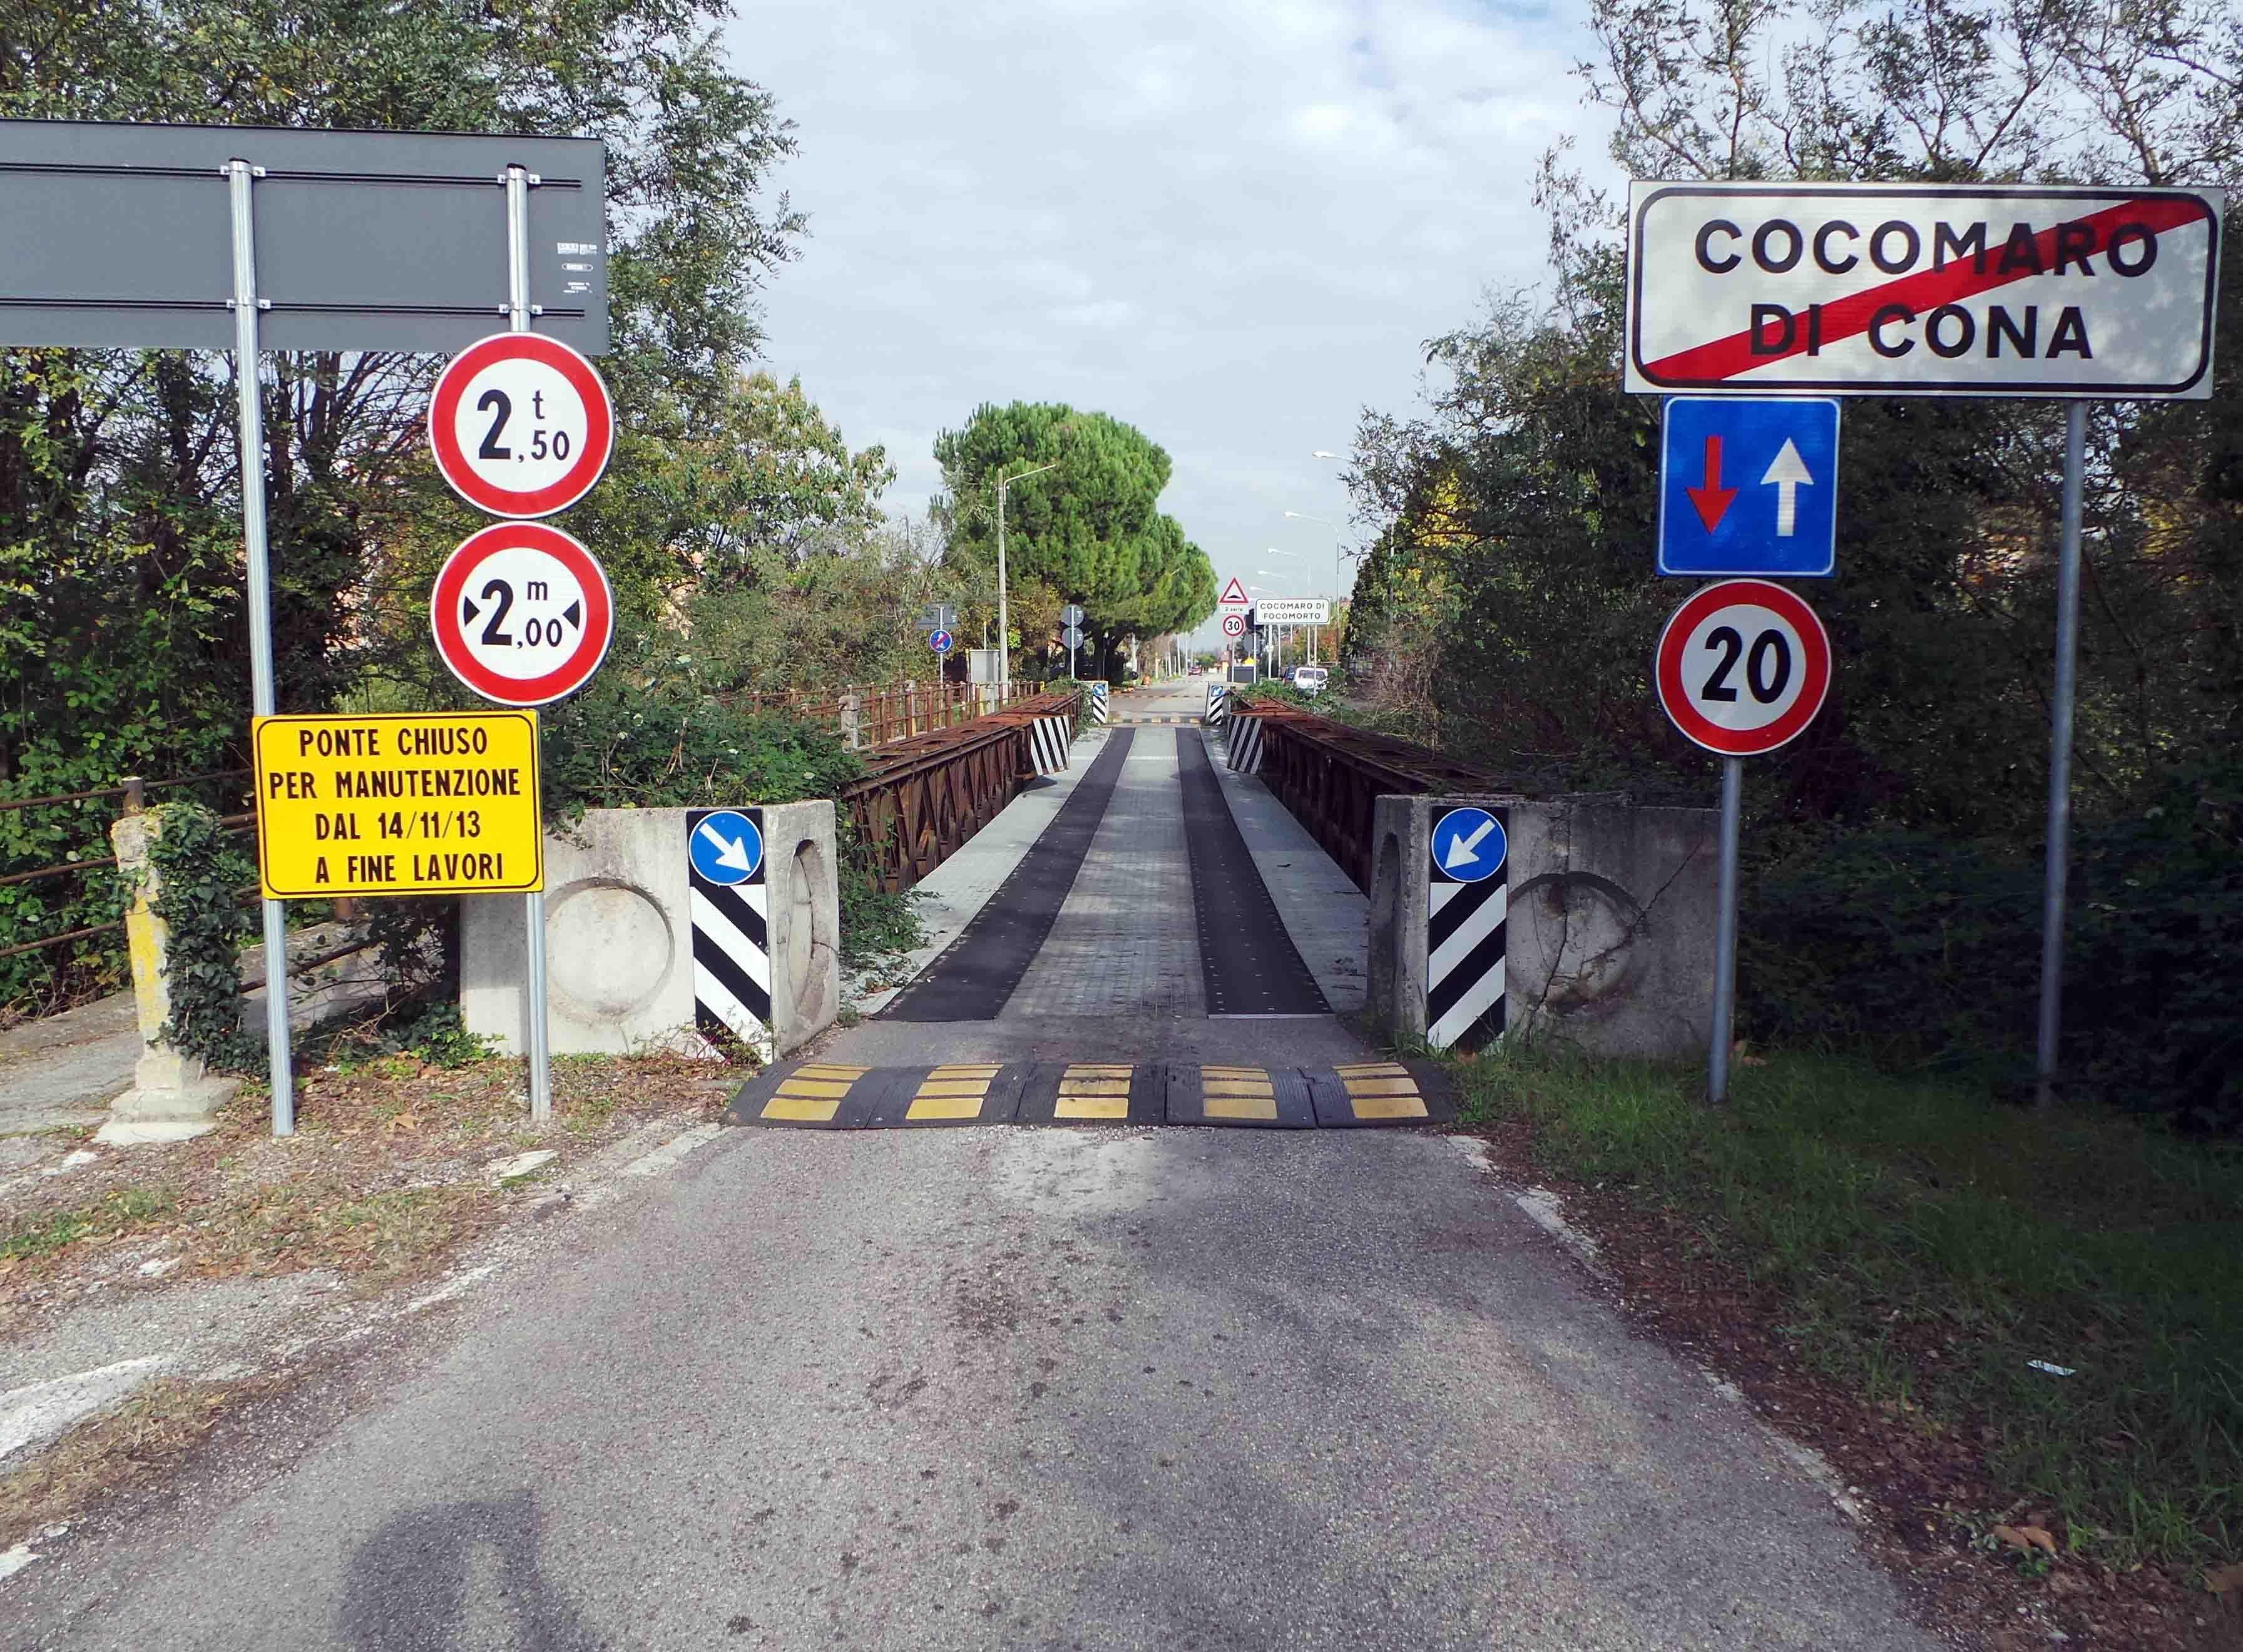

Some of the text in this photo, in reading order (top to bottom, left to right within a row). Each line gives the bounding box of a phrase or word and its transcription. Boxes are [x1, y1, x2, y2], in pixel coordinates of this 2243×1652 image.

[1695, 218, 2159, 278] COCOMARO
[1750, 303, 2093, 360] DI CONA
[532, 390, 545, 419] t
[527, 581, 548, 601] m
[1227, 621, 1240, 631] 30
[1701, 625, 1791, 704] 20
[299, 727, 488, 757] PONTE CHIUSO
[269, 768, 521, 800] PER MANUTENZIONE
[315, 810, 481, 840] DAL 14/11/13
[315, 853, 503, 884] A FINE LAVORI
